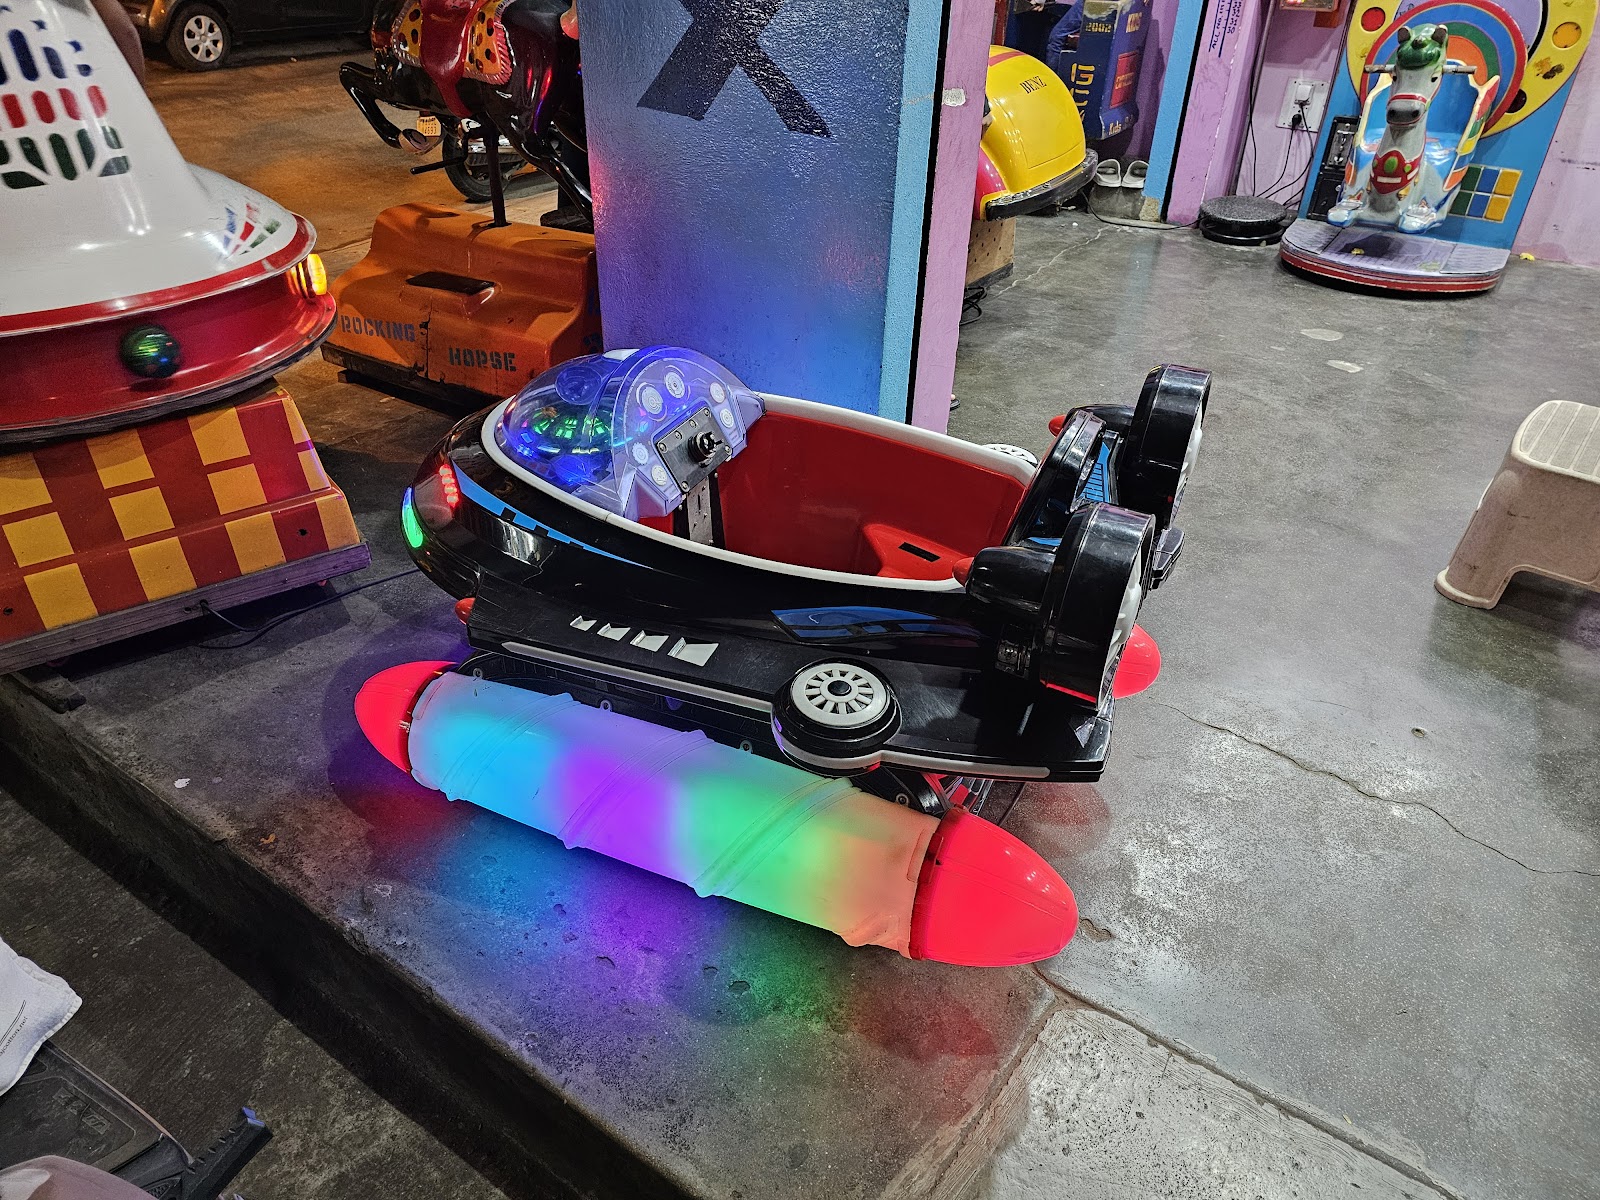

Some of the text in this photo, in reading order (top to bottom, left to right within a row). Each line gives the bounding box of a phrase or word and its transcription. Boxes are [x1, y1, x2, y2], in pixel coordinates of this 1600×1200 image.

[1019, 75, 1047, 94] BENZ
[340, 314, 416, 343] ROCKING
[448, 347, 517, 372] HORSE
